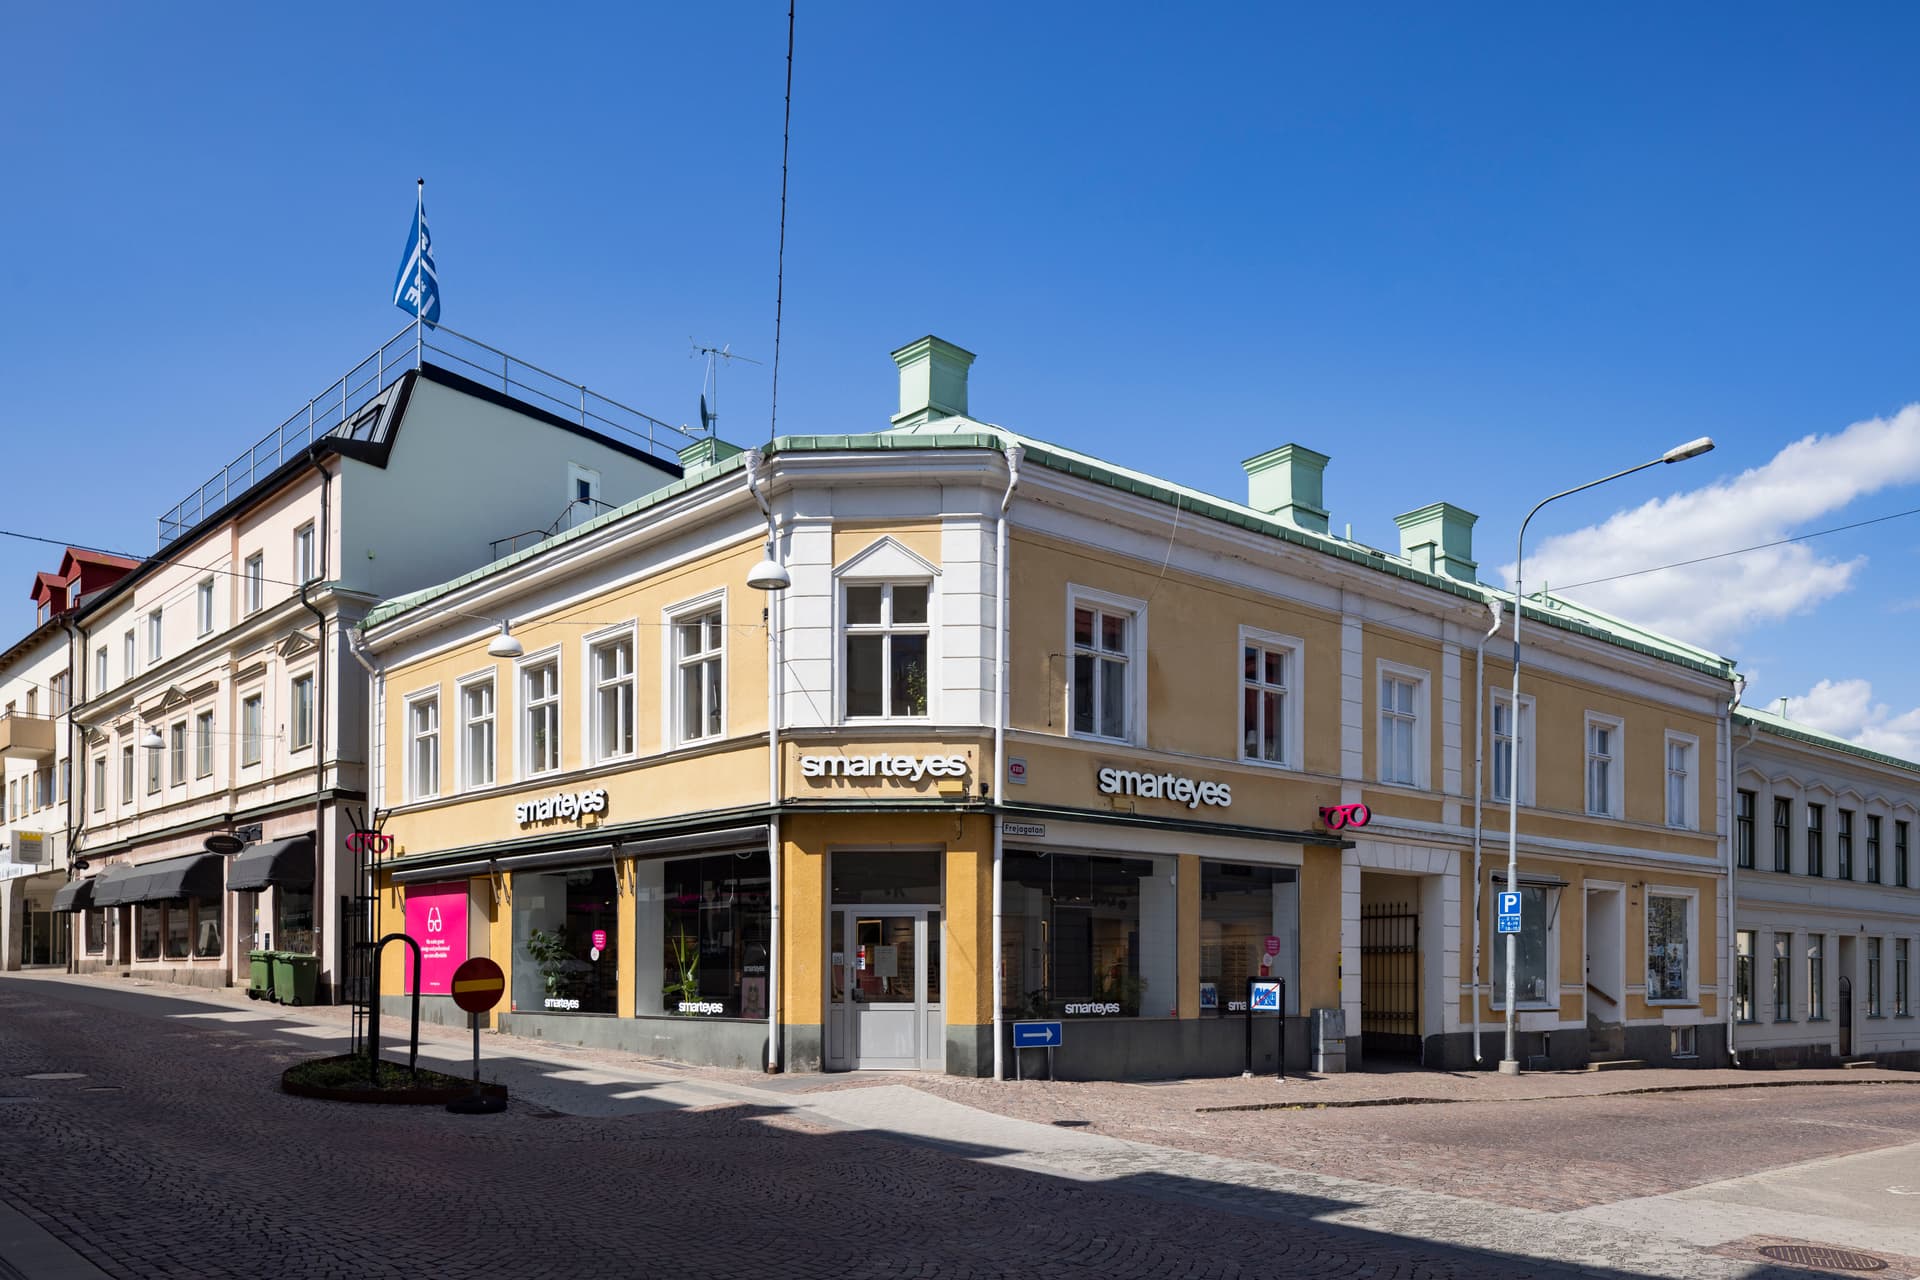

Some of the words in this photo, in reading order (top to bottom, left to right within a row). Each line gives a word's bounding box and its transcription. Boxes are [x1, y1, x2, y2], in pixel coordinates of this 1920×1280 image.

[800, 752, 967, 782] smarteyes
[1099, 767, 1232, 809] smarteyes
[515, 789, 605, 823] smarteyes
[1005, 823, 1043, 836] Frejagatan
[1504, 894, 1518, 913] P
[544, 997, 580, 1011] smarteyes
[678, 1001, 724, 1015] smarteyes
[1064, 1002, 1120, 1016] smarteyes
